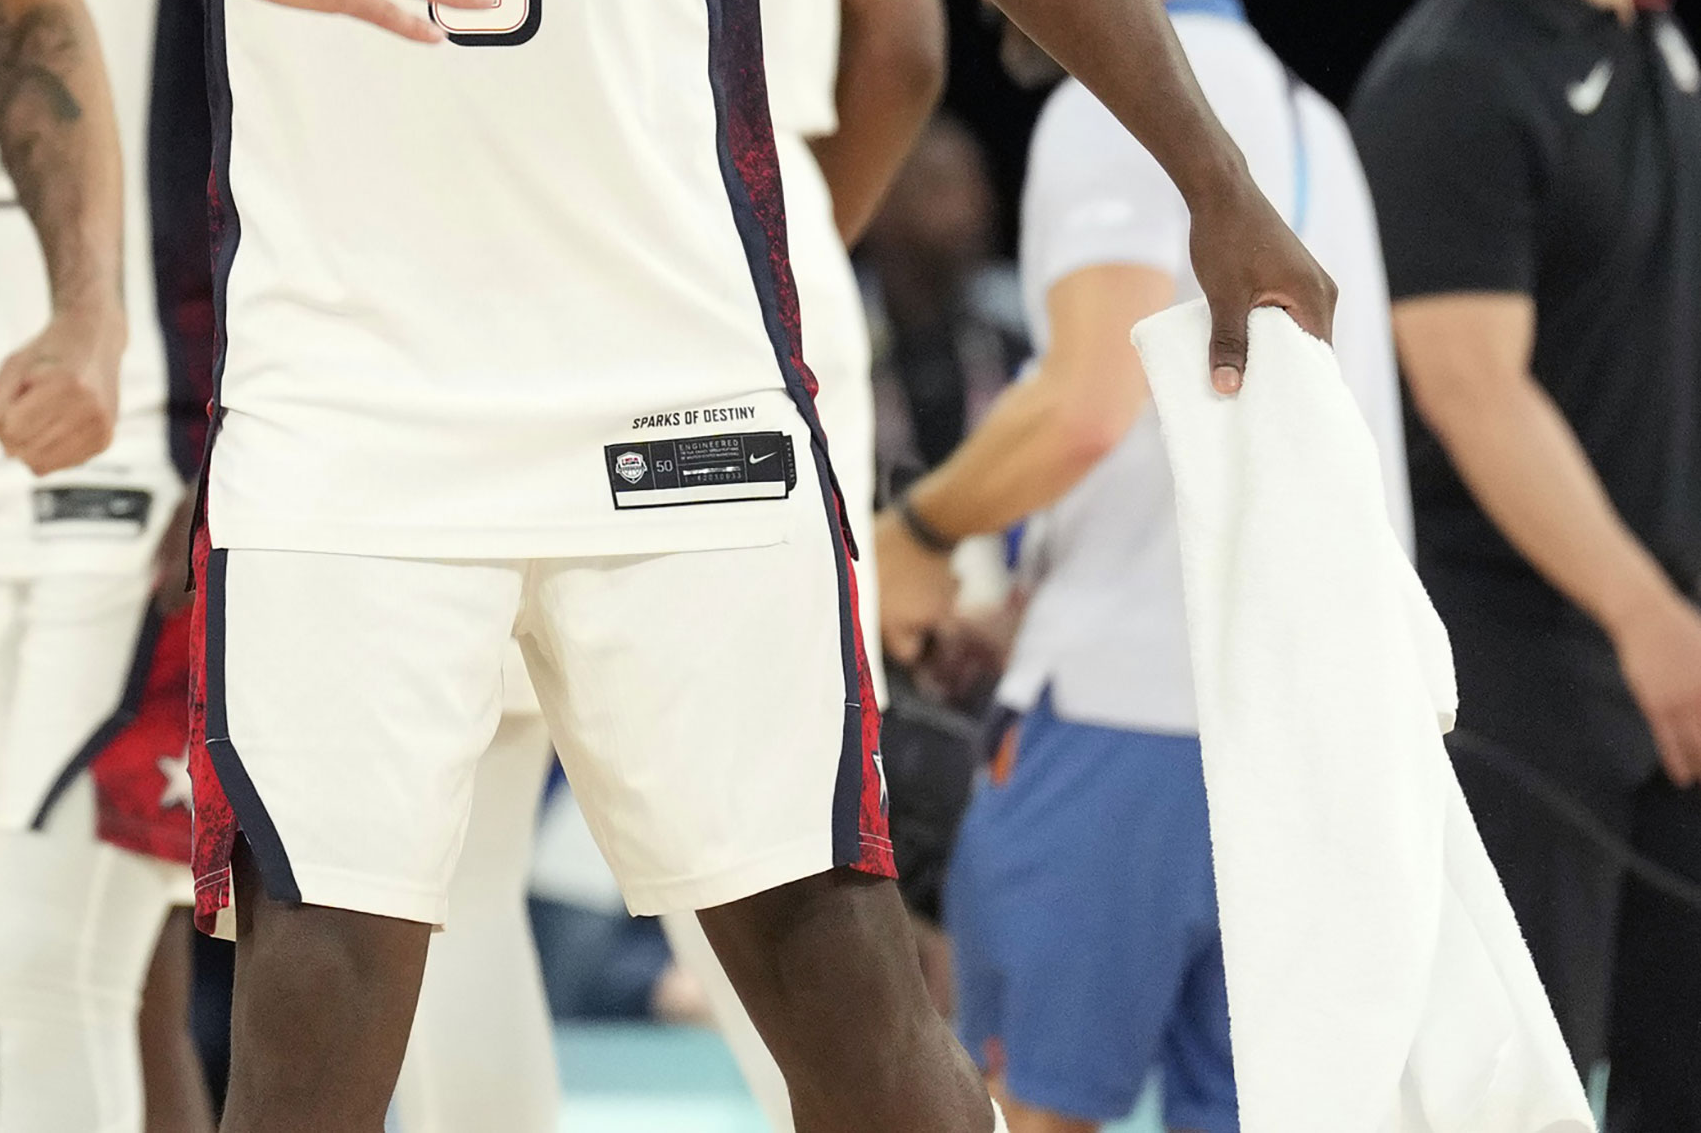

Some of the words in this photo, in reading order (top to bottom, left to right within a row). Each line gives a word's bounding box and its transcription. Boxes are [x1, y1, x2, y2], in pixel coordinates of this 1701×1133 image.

[632, 412, 680, 429] SPARKS
[685, 410, 700, 425] OF
[704, 406, 756, 423] DESTINY
[678, 439, 740, 451] ENGINEERED
[656, 459, 673, 473] 50
